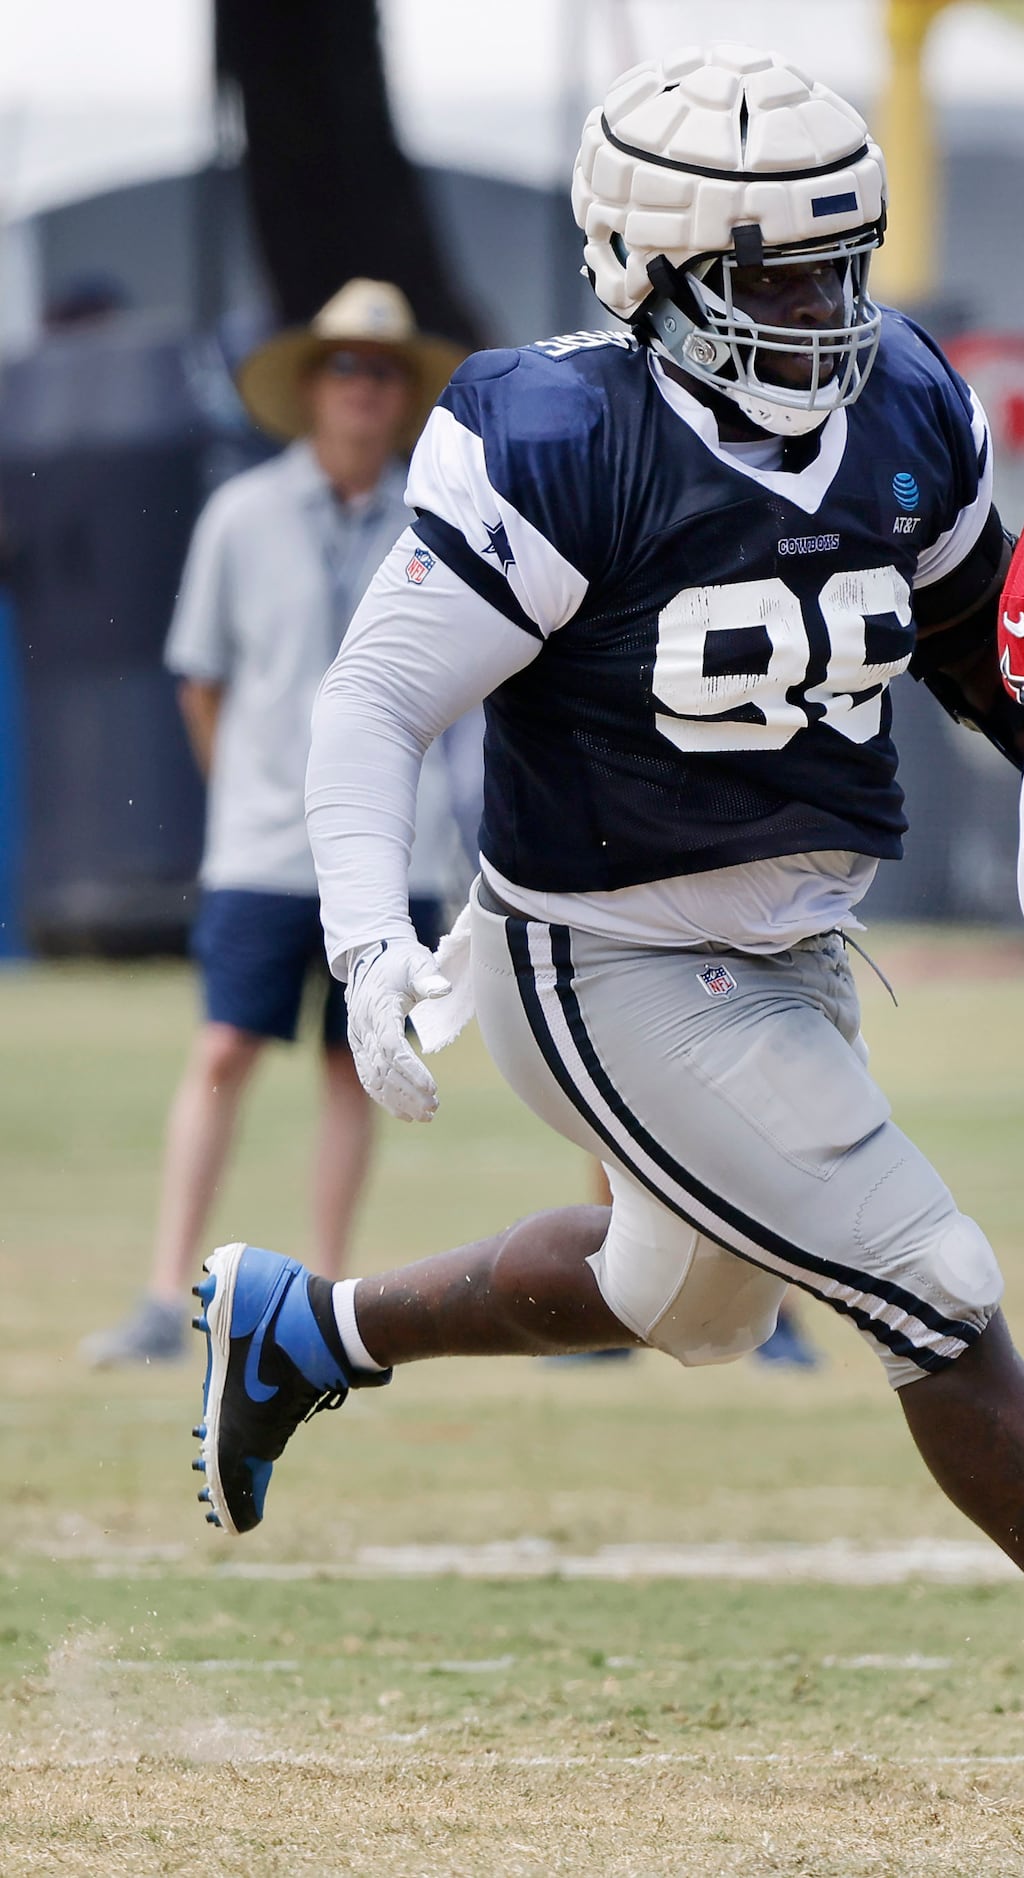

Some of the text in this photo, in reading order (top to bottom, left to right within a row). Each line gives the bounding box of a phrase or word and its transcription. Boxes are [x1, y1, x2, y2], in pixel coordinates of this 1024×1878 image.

[892, 516, 921, 534] AT&T
[777, 533, 840, 556] COWBOYS
[708, 976, 733, 993] NFL
